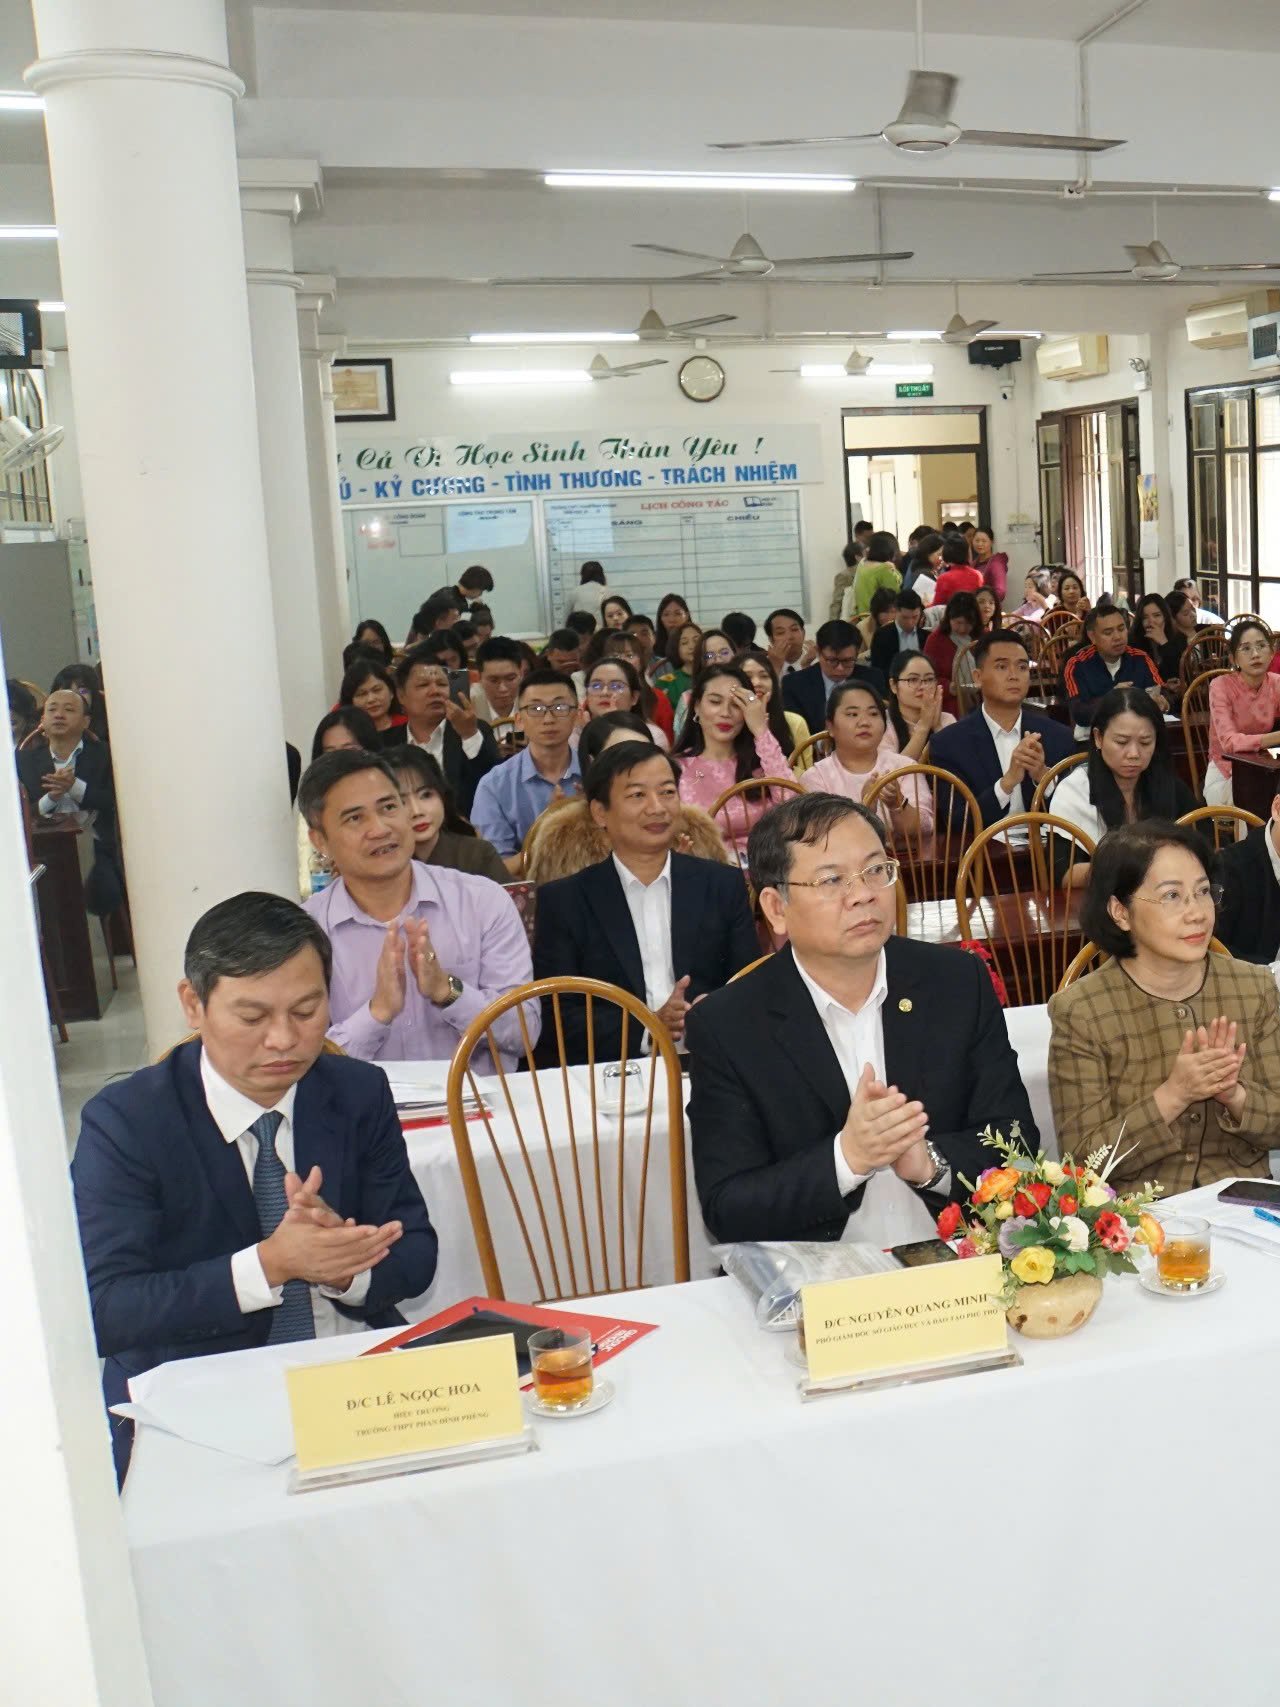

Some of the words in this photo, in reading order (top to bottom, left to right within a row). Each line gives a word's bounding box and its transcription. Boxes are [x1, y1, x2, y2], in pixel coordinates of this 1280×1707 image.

[356, 448, 394, 470] Cả
[455, 442, 513, 469] Học
[522, 440, 587, 464] Sinh
[599, 437, 671, 460] Thân
[682, 435, 738, 462] Yêu
[754, 437, 764, 455] !
[375, 474, 402, 498] KỶ
[504, 471, 551, 492] TÌNH
[560, 468, 642, 490] THƯƠNG
[661, 463, 725, 484] TRÁCH
[735, 461, 797, 484] NHIỆM
[640, 501, 669, 511] LỊCH
[671, 499, 704, 510] CÔNG
[708, 499, 729, 509] TÁC
[824, 1316, 845, 1329] Đ/C
[849, 1306, 902, 1326] NGUYỄN
[906, 1299, 951, 1316] QUANG
[954, 1293, 987, 1306] MINH
[346, 1397, 371, 1411] Đ/C
[376, 1391, 396, 1406] LÊ
[400, 1387, 445, 1402] NGỌC
[448, 1383, 481, 1397] HOA
[393, 1421, 414, 1432] THPT
[416, 1418, 438, 1428] PHAN
